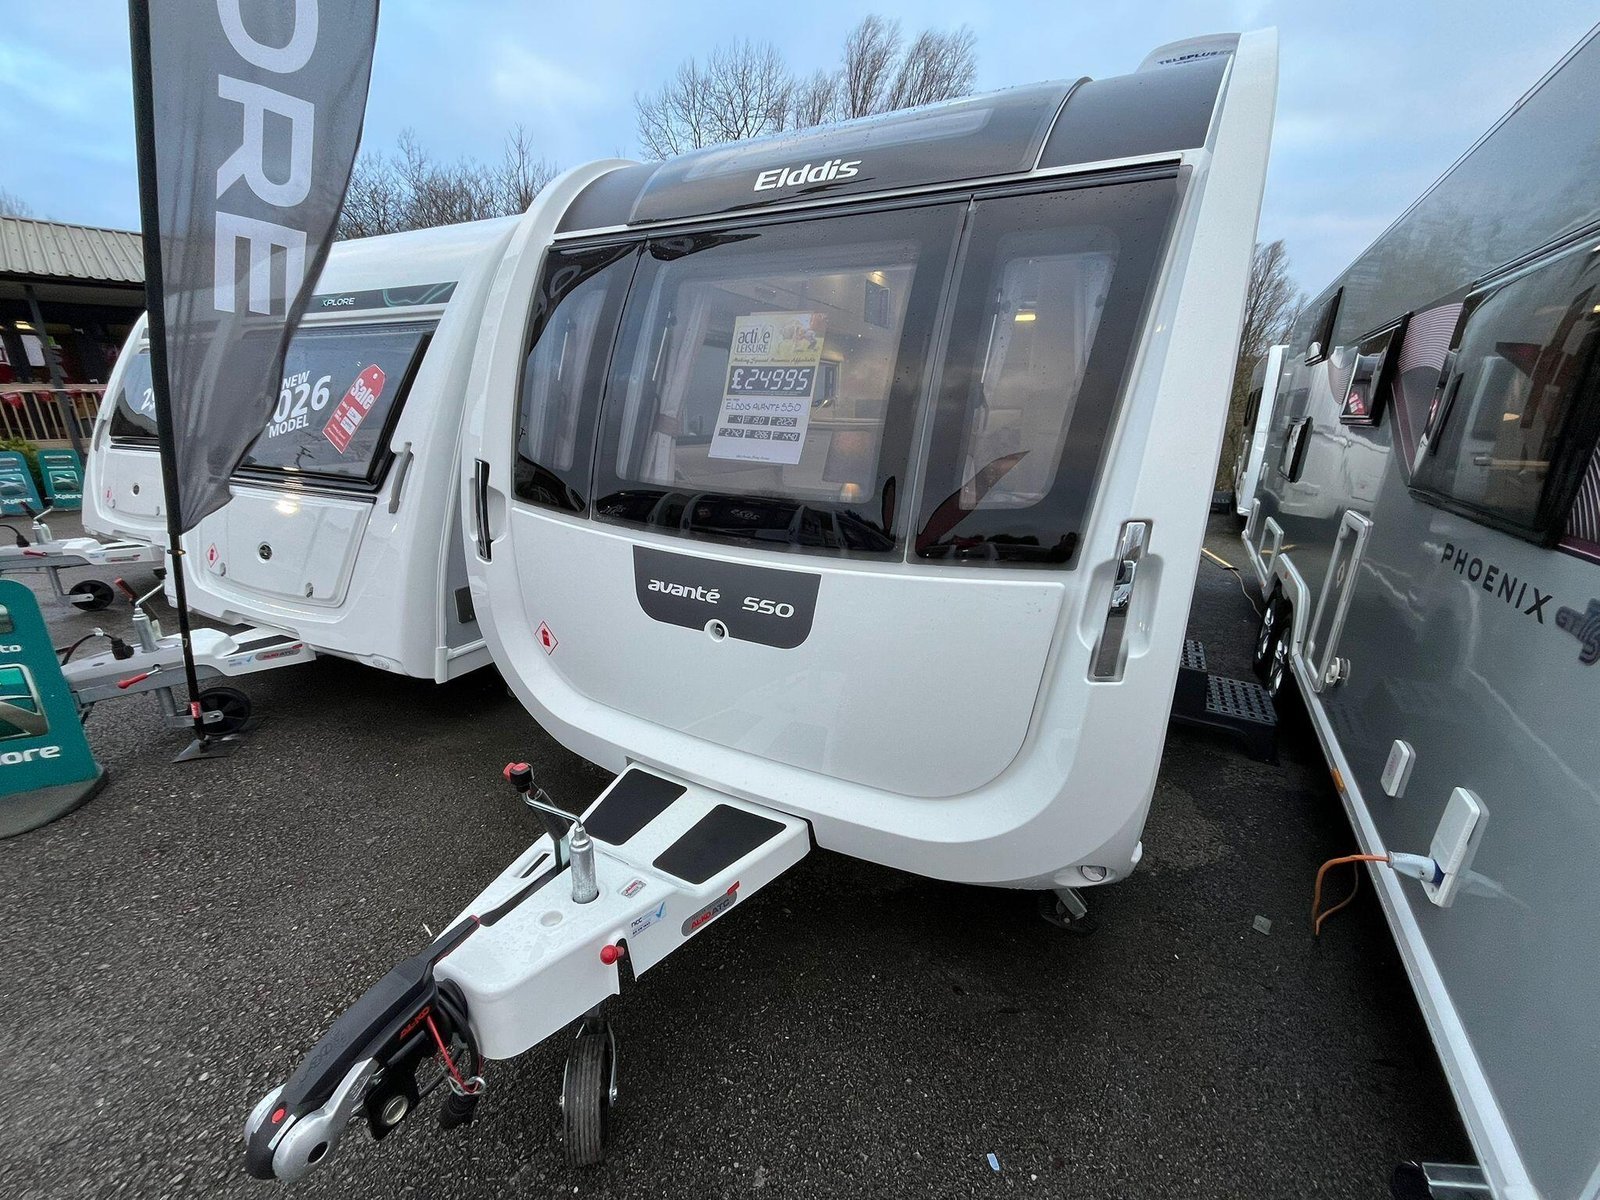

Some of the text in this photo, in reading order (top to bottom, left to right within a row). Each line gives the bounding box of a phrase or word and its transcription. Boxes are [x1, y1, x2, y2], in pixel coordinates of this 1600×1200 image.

[754, 159, 862, 191] Elddis
[321, 297, 355, 307] XPLORE
[736, 343, 768, 354] LEISURE
[282, 371, 310, 390] NEW
[350, 378, 375, 410] Sale
[266, 375, 331, 427] 026
[268, 415, 309, 438] MODEL
[1440, 543, 1553, 624] PHOENIX
[648, 579, 795, 618] avanté 550
[0, 745, 61, 766] ore
